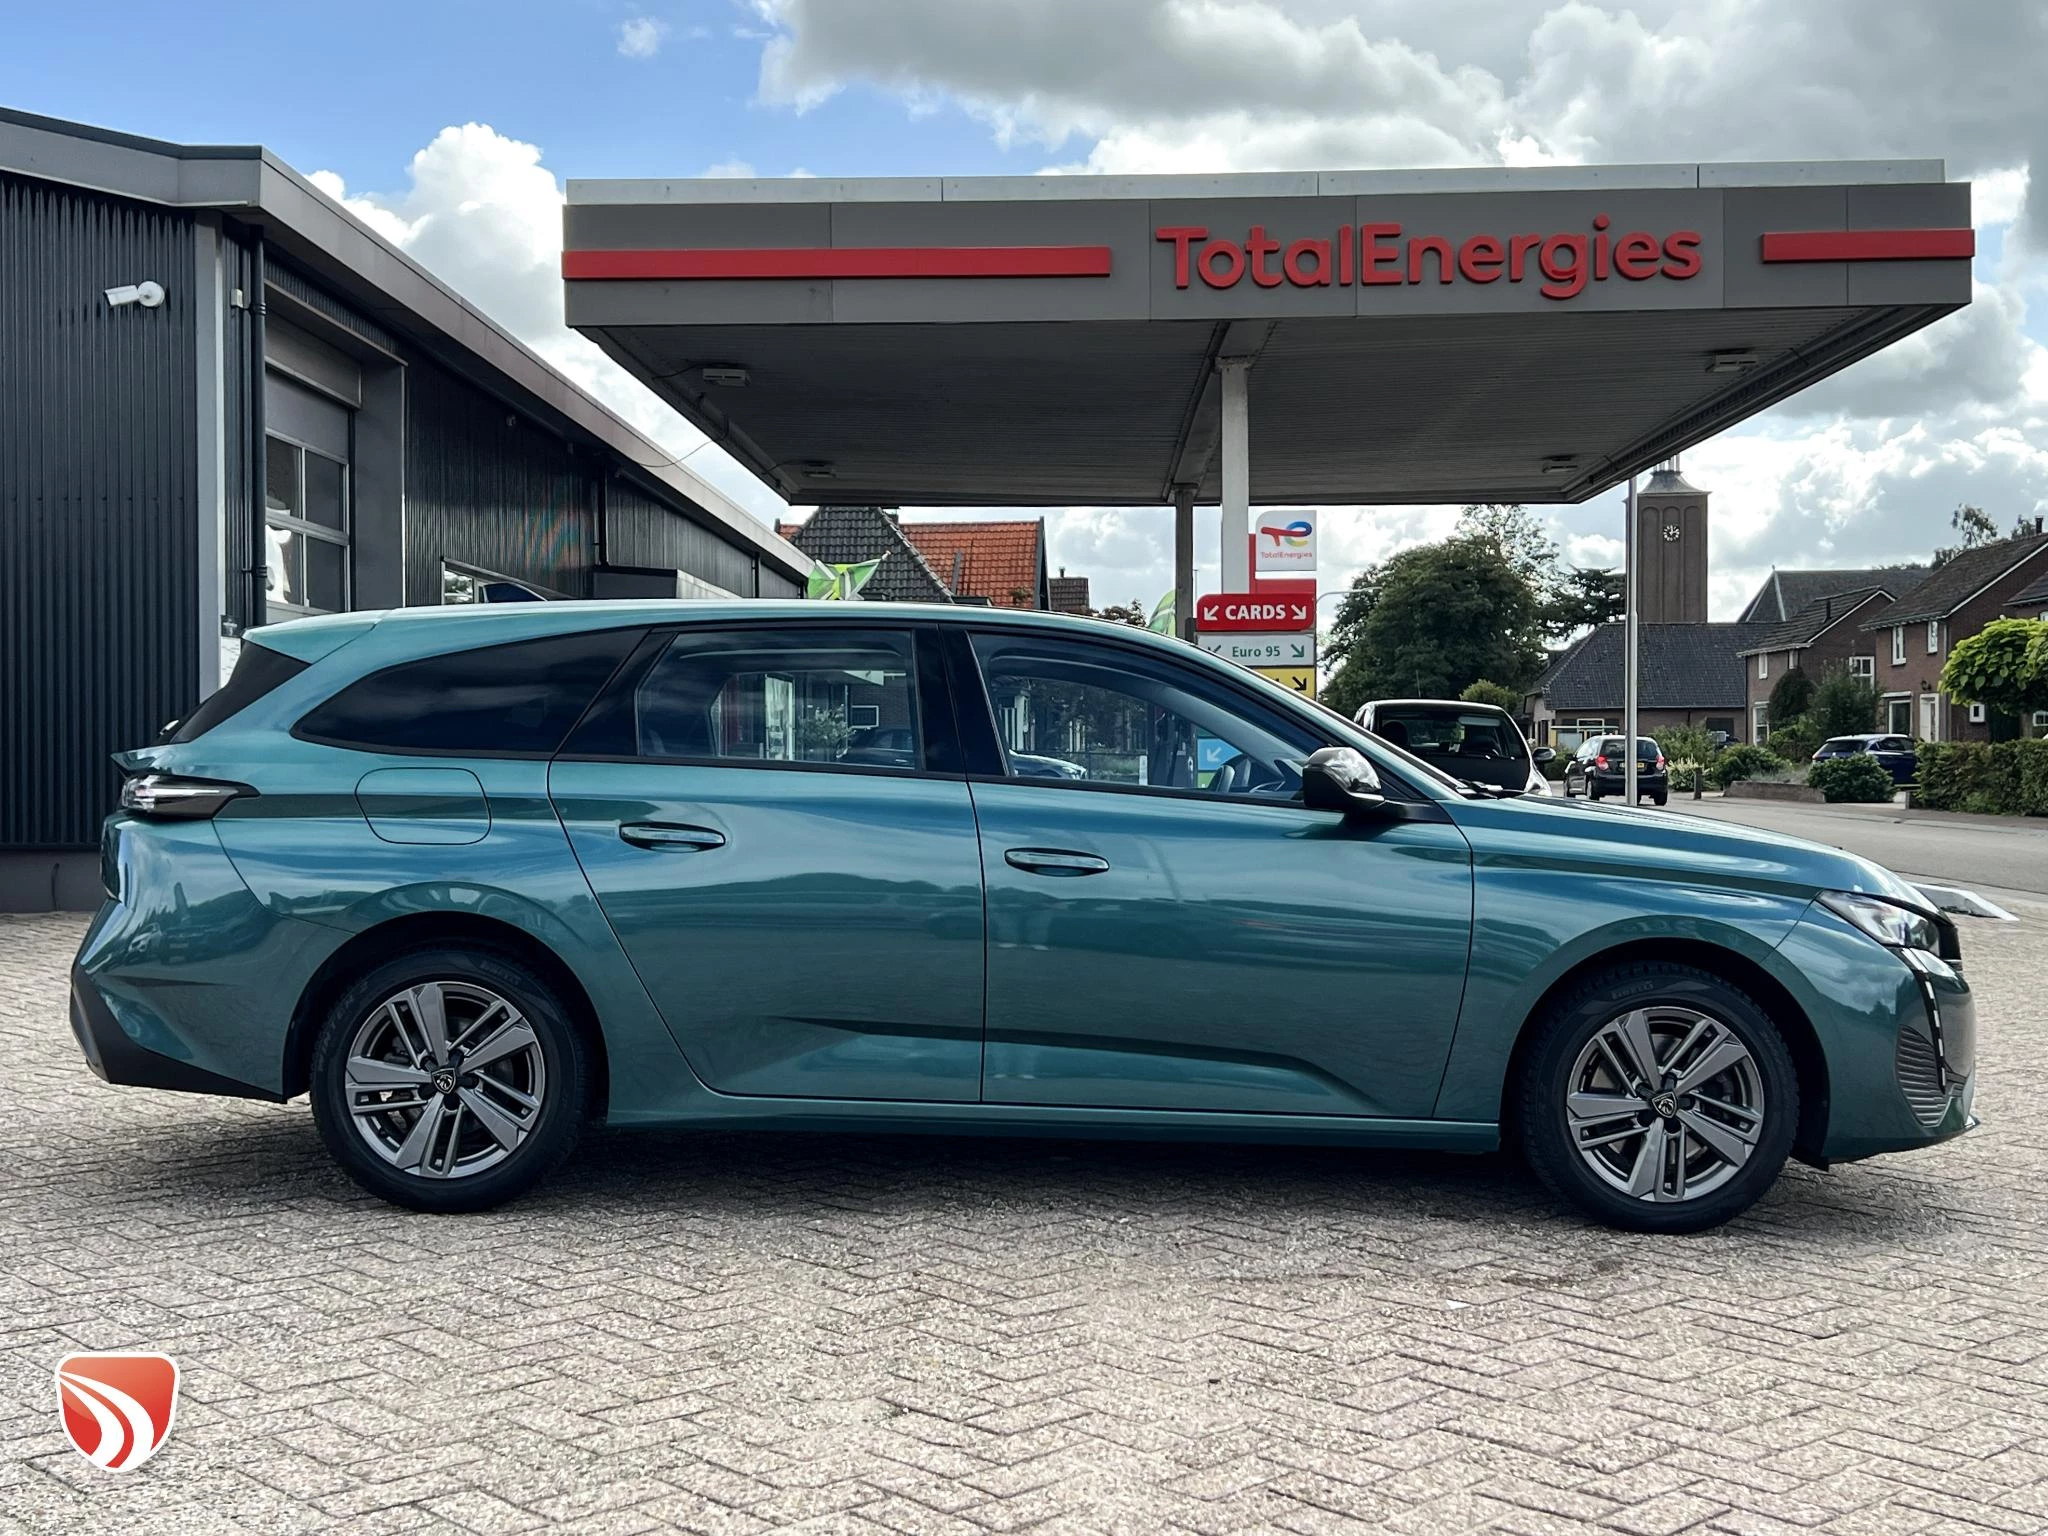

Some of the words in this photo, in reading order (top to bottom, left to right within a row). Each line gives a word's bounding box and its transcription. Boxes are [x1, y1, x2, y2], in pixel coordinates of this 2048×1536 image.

[1155, 213, 1703, 300] TotalEnergies
[1225, 604, 1286, 620] CARDS
[1232, 646, 1261, 657] Euro
[1265, 645, 1280, 657] 95
